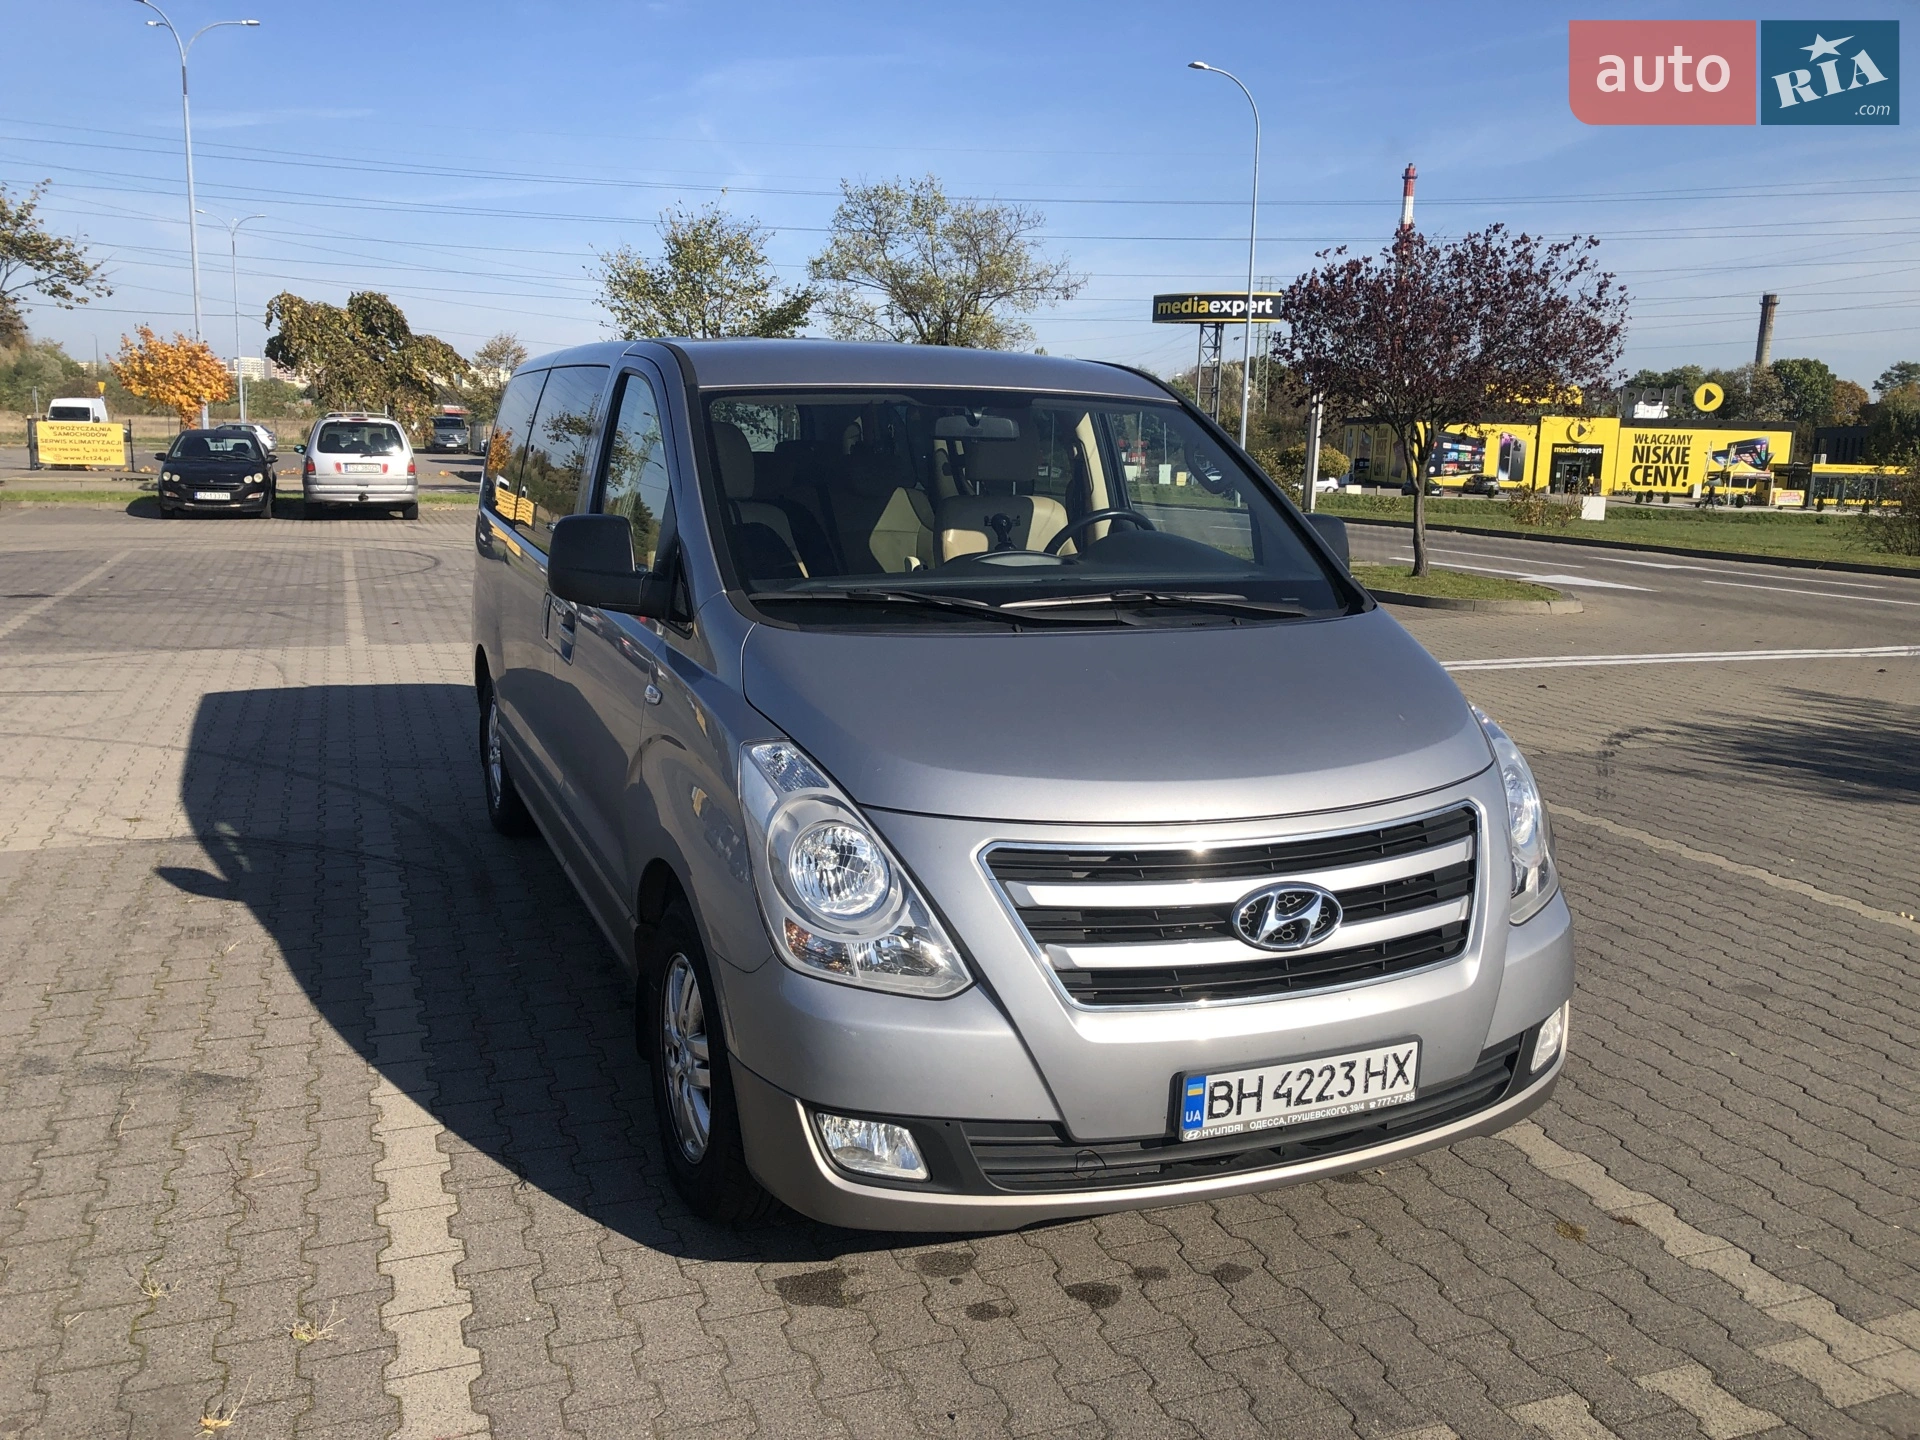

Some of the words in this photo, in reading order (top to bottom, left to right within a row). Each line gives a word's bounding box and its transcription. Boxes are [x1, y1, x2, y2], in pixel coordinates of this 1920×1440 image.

[1634, 433, 1693, 446] WŁĄCZAMY
[1554, 446, 1602, 455] mediaexpert
[1632, 445, 1691, 465] NISKIE
[1630, 465, 1689, 487] CENY!
[1207, 1075, 1264, 1120] BH
[1273, 1060, 1357, 1108] 4223
[1363, 1049, 1414, 1094] HX
[1185, 1110, 1201, 1123] UA
[1249, 1117, 1287, 1130] ОДЕССА,
[1377, 1092, 1415, 1107] 777-77-85
[1202, 1124, 1243, 1137] HYUNDAI
